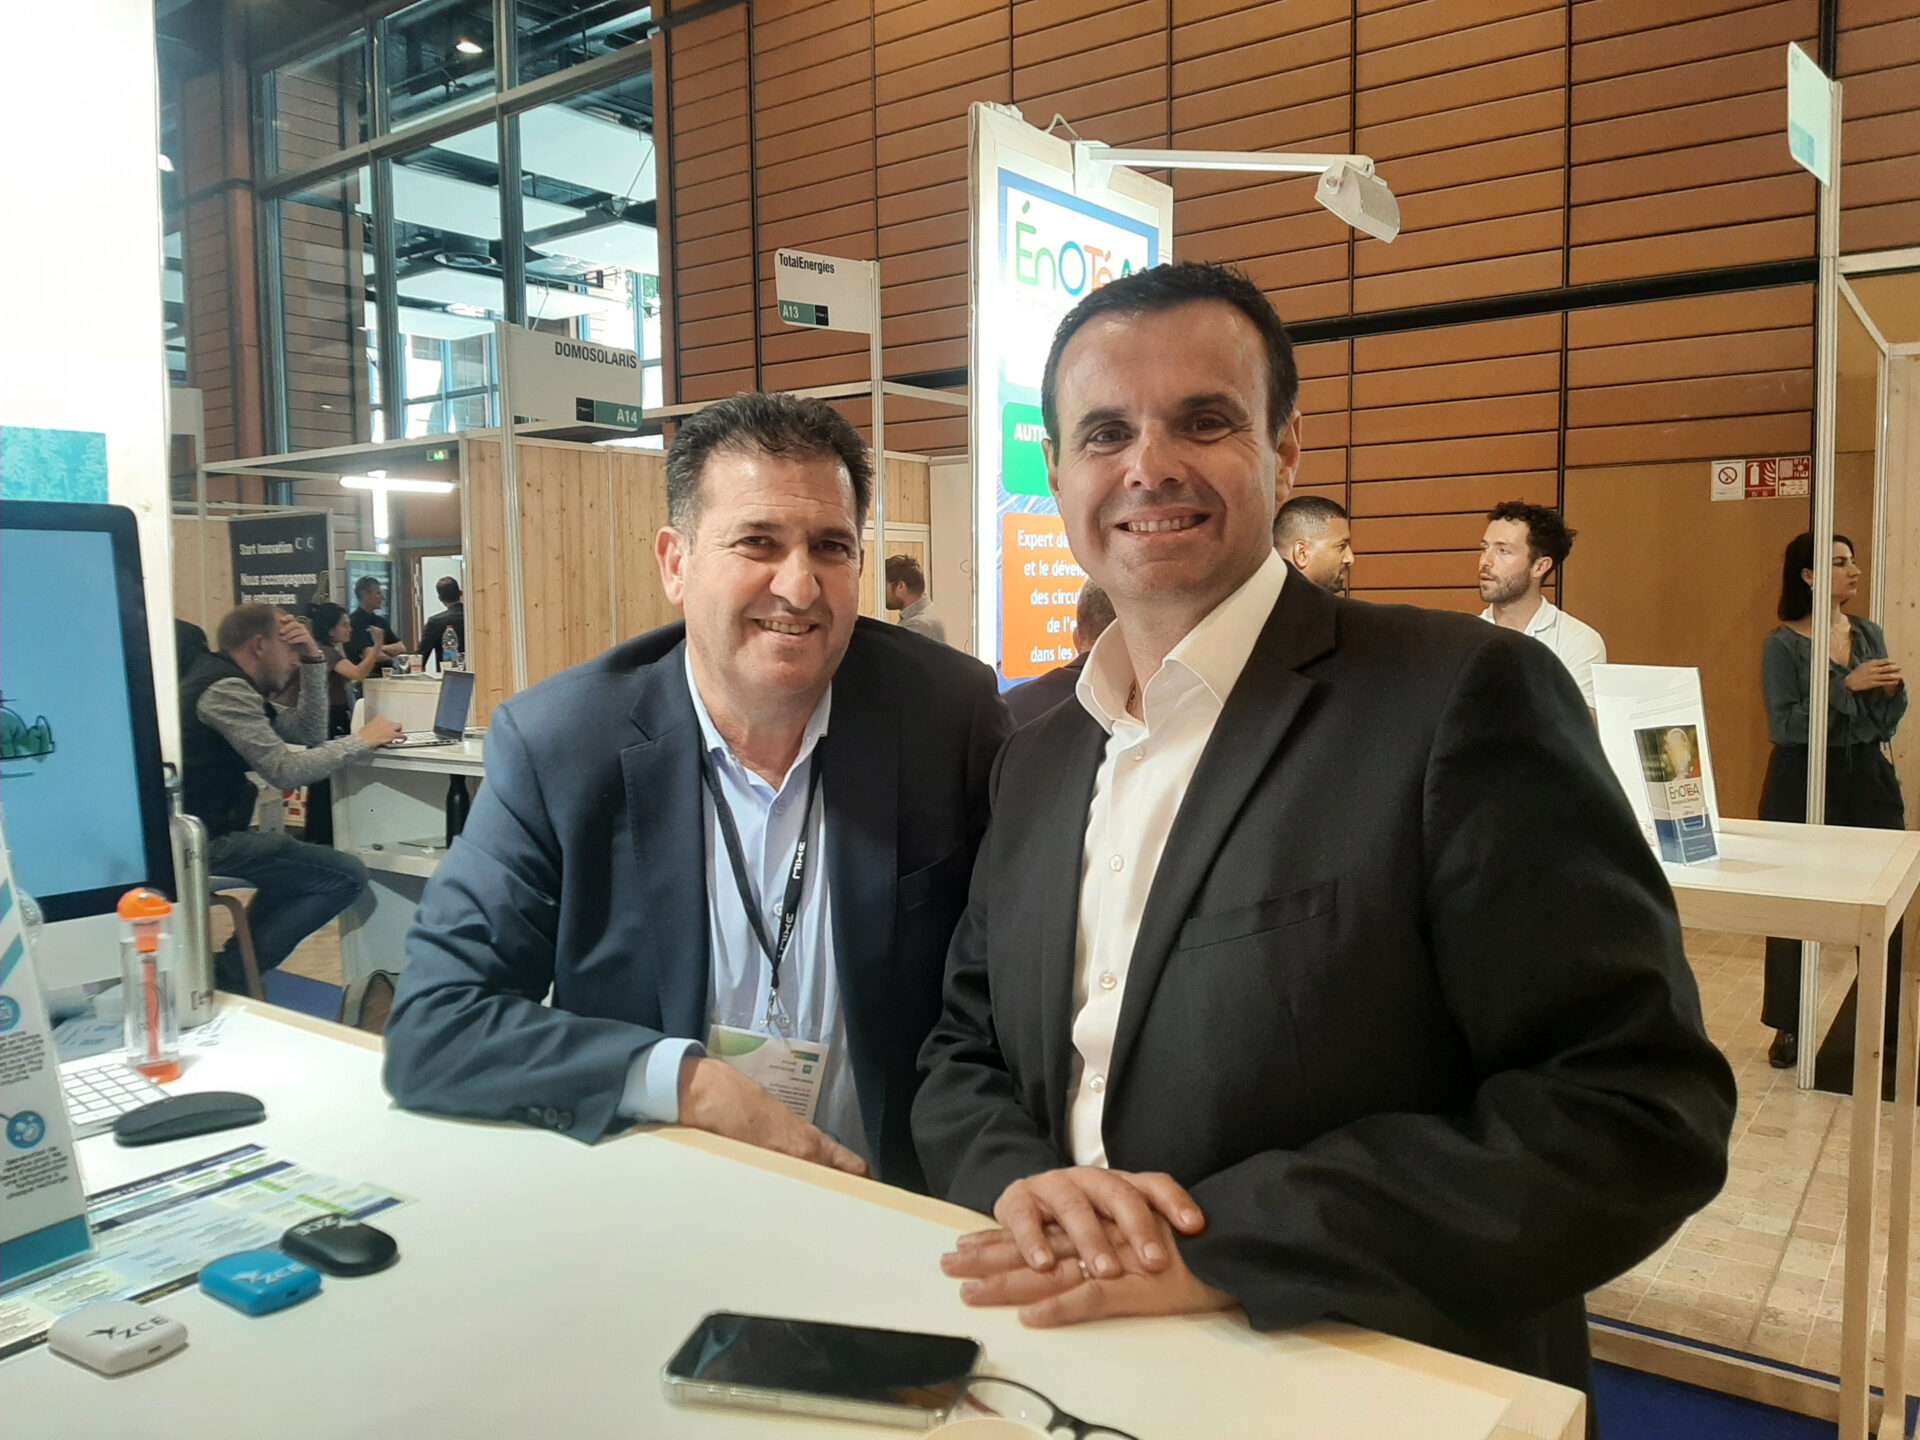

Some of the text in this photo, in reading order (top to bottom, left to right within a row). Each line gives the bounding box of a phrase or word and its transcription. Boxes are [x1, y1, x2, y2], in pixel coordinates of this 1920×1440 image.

[778, 253, 835, 274] TotalEnergies
[782, 304, 800, 319] A13
[554, 340, 637, 369] DOMOSOLARIS
[616, 408, 638, 425] A14
[1017, 529, 1054, 550] Expert
[1023, 561, 1036, 577] et
[1039, 560, 1049, 577] le
[1030, 587, 1049, 606] des
[1046, 616, 1061, 633] de
[1030, 643, 1073, 663] dans les
